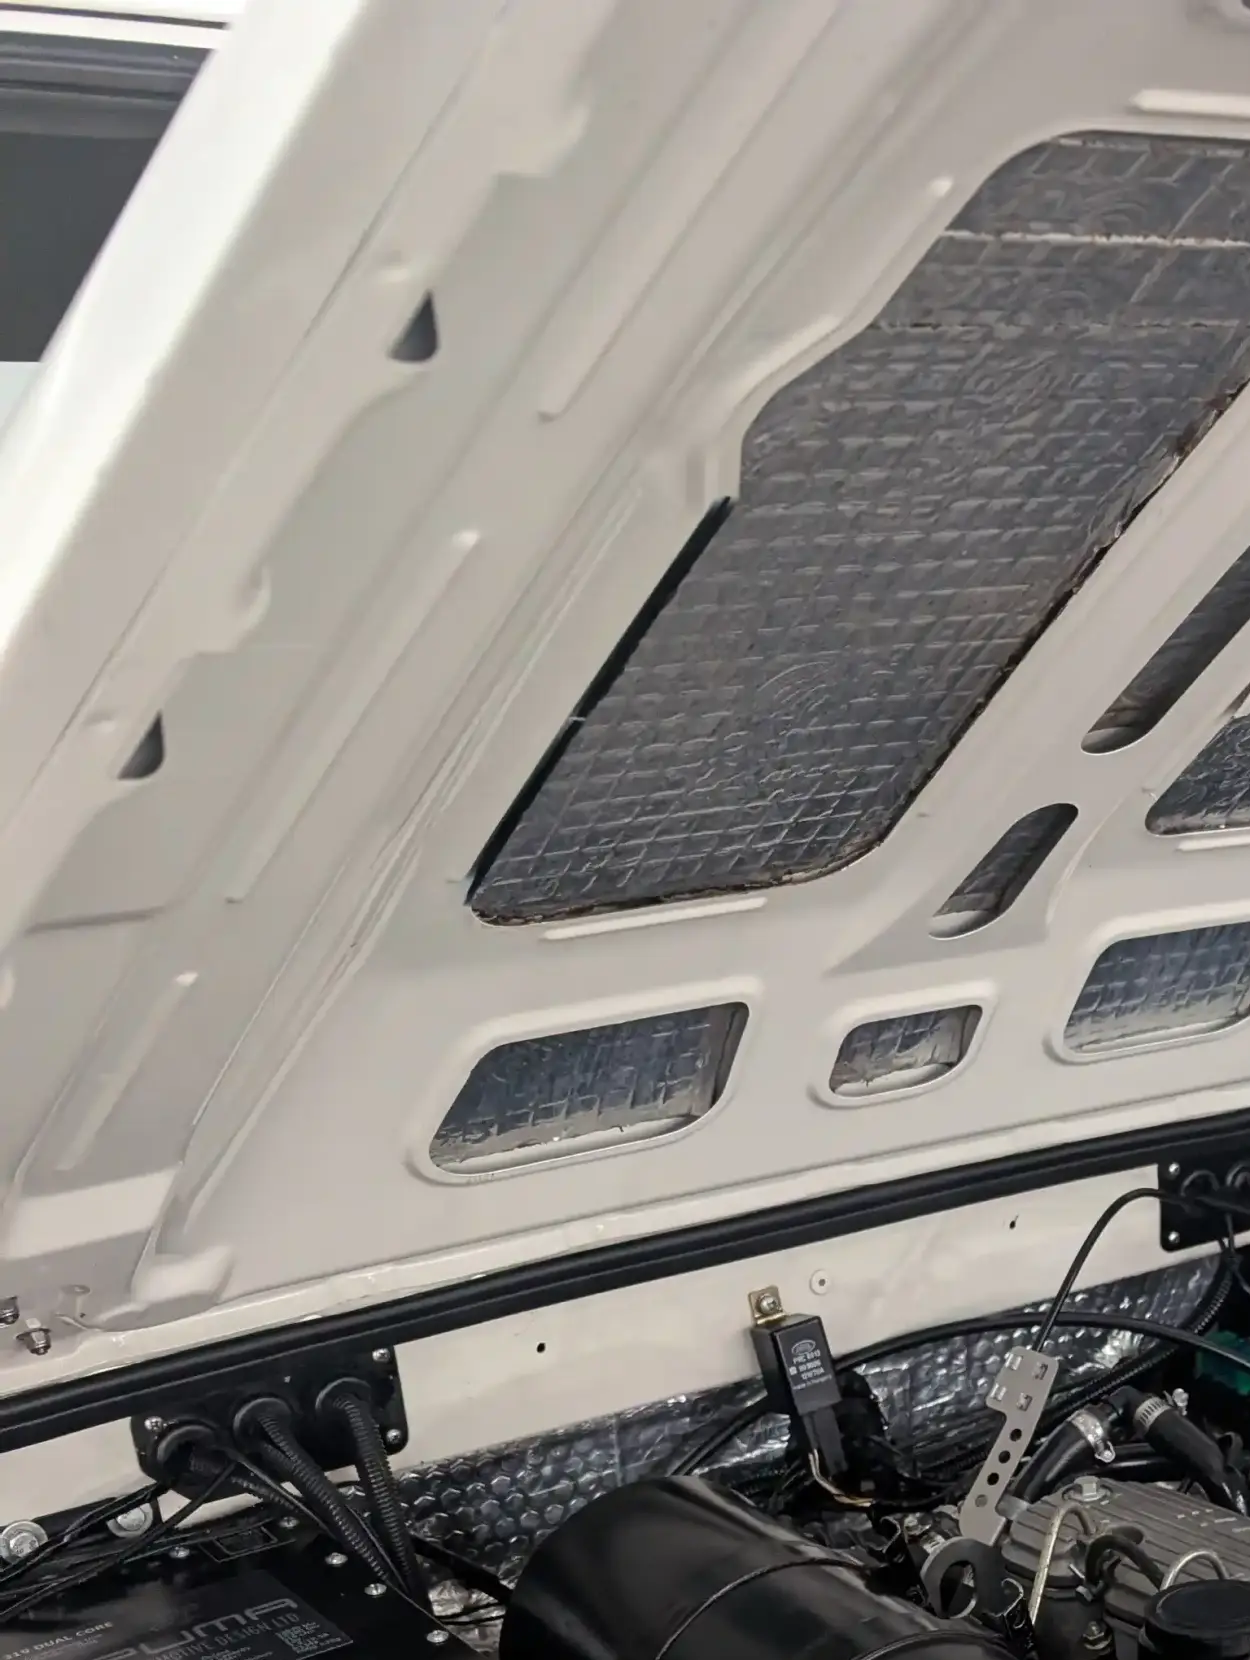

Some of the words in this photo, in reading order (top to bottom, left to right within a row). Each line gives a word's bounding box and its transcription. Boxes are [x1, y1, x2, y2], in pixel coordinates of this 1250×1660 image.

[34, 1636, 73, 1651] DUAL
[75, 1621, 114, 1637] CORE
[214, 1619, 272, 1649] DESIGN
[271, 1611, 300, 1630] LTD
